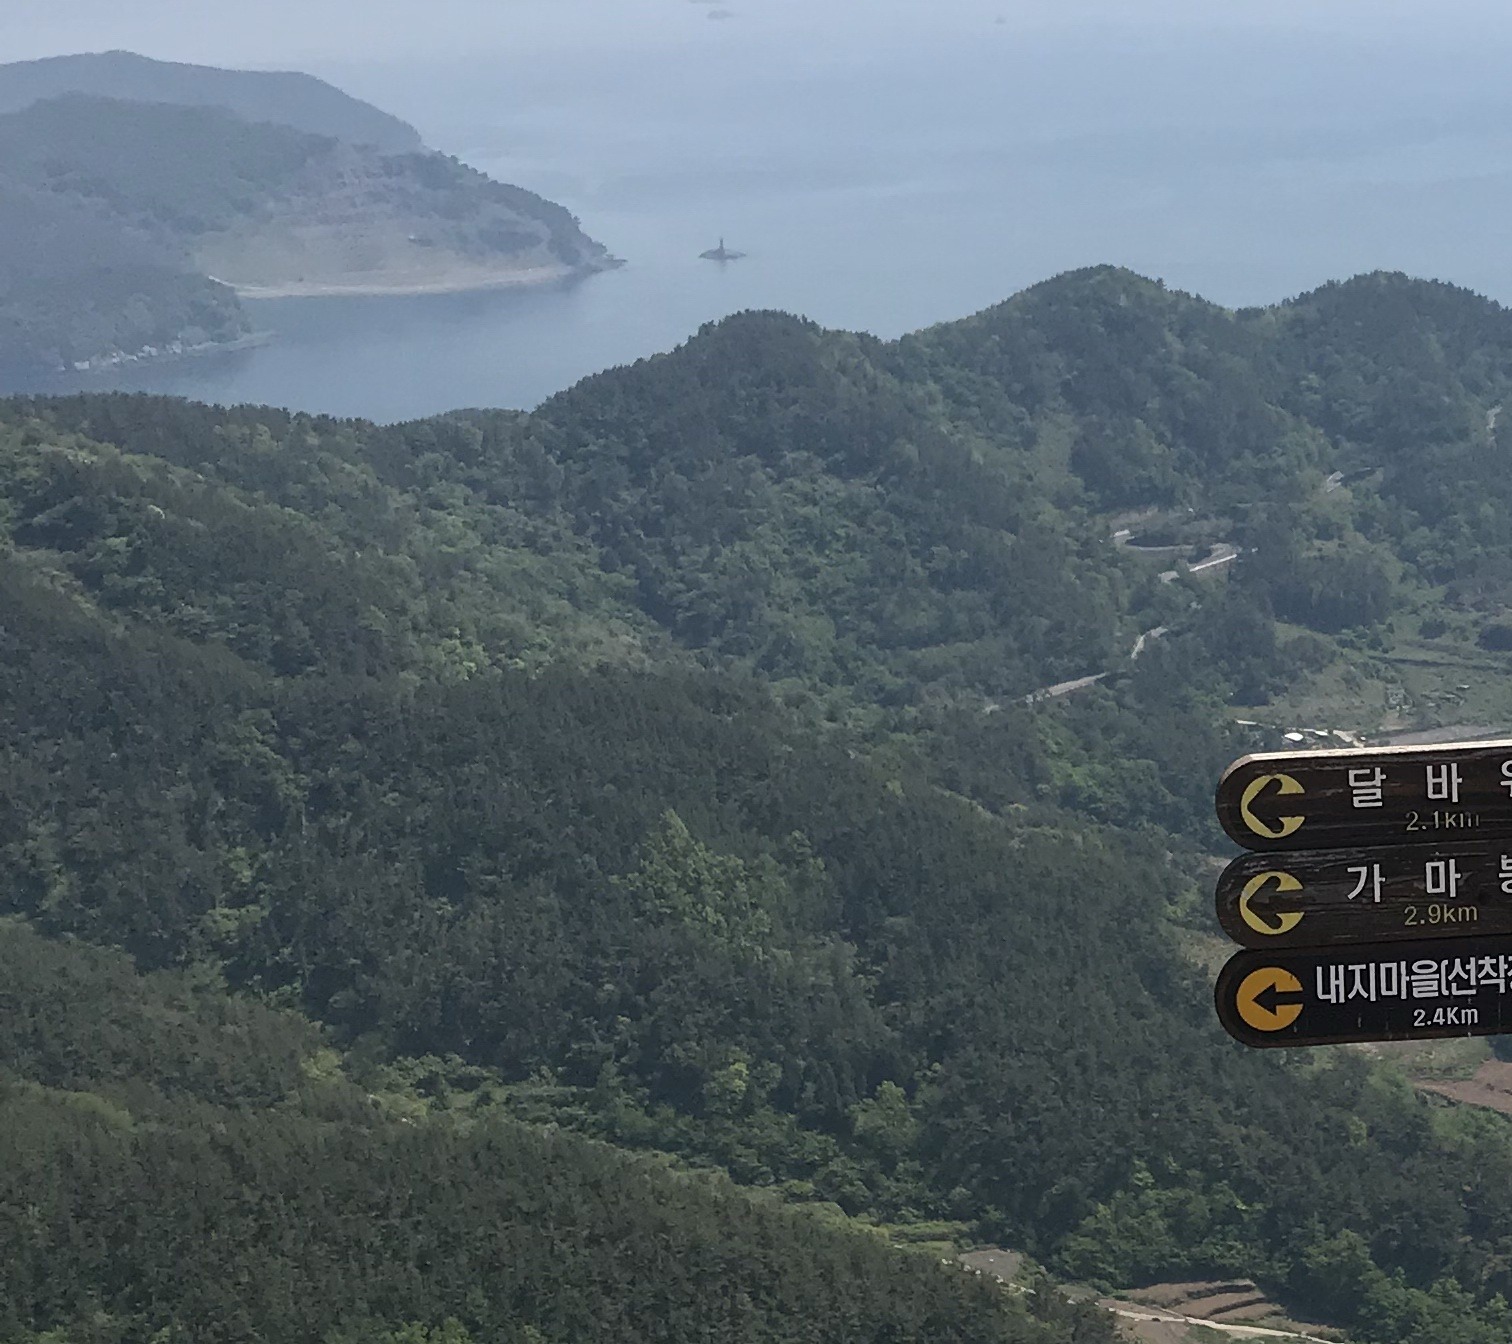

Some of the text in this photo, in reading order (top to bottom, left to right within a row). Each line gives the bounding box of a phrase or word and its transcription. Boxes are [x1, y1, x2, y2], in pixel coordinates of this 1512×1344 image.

[1405, 810, 1480, 832] 2.1km
[1404, 904, 1478, 927] 2.9km
[1413, 1006, 1479, 1028] 2.4Km
